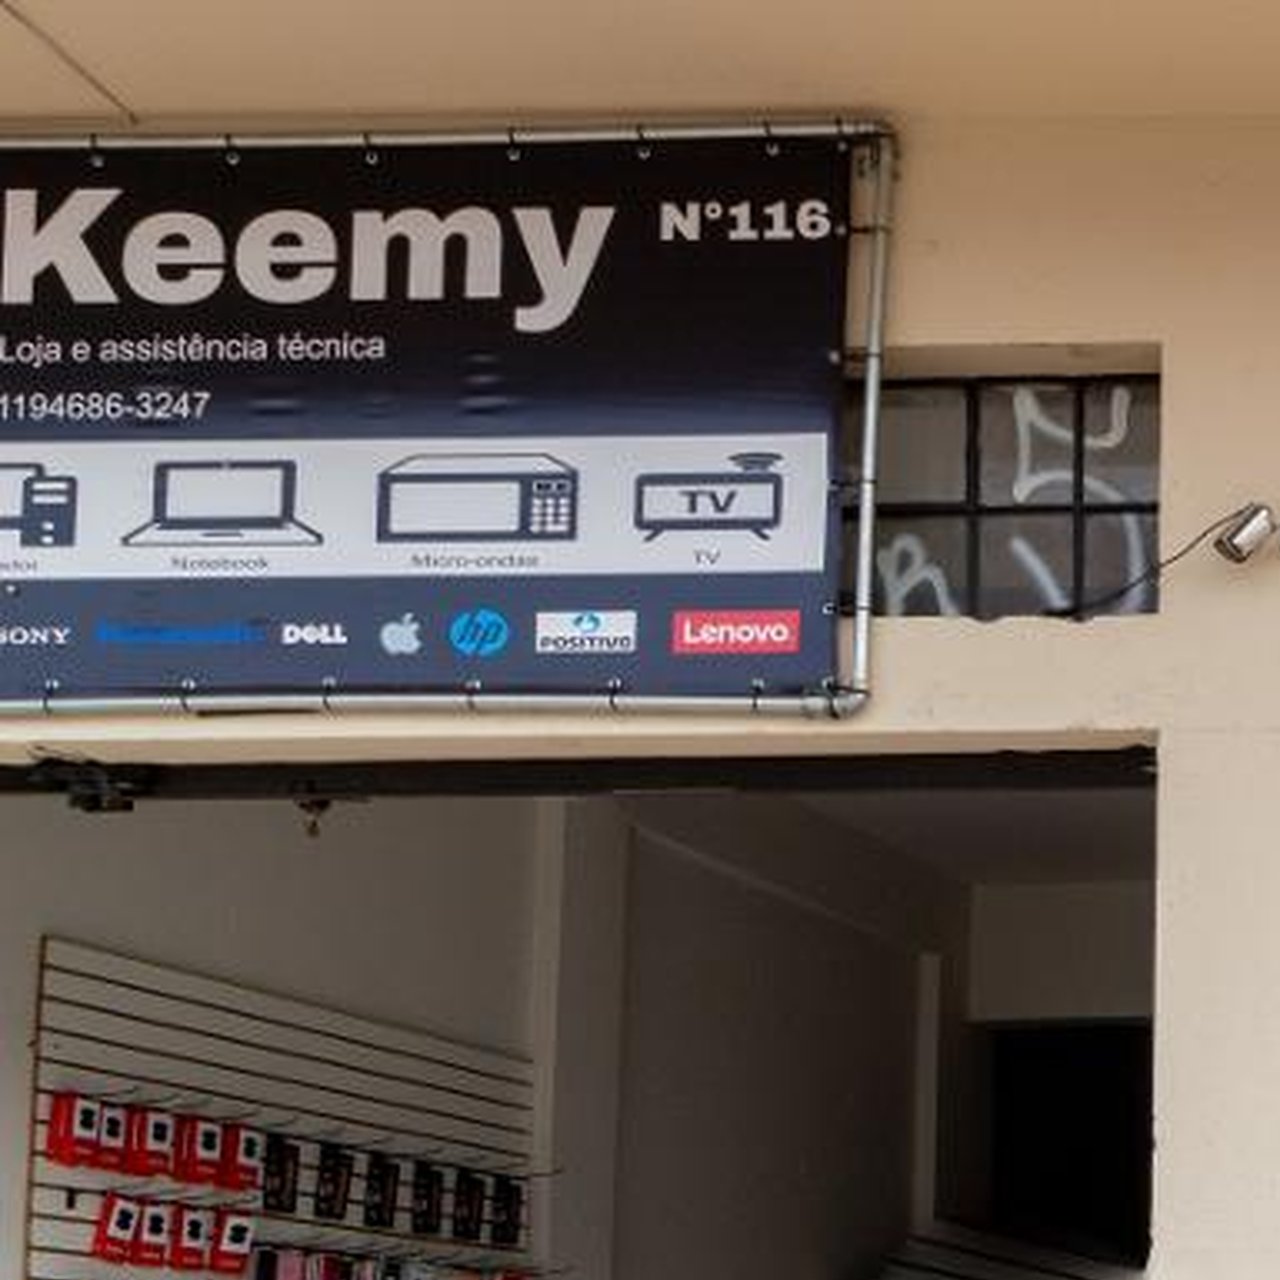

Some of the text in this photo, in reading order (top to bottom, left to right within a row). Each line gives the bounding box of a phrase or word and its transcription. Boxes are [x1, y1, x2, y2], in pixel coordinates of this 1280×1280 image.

[1, 188, 615, 332] Keemy
[0, 331, 386, 368] Loja e assistência técnica
[680, 489, 737, 513] TV
[693, 550, 721, 565] TV
[282, 623, 348, 645] DELL
[454, 609, 504, 655] hp
[540, 635, 632, 649] POSITIVO
[683, 619, 790, 643] Lenovo
